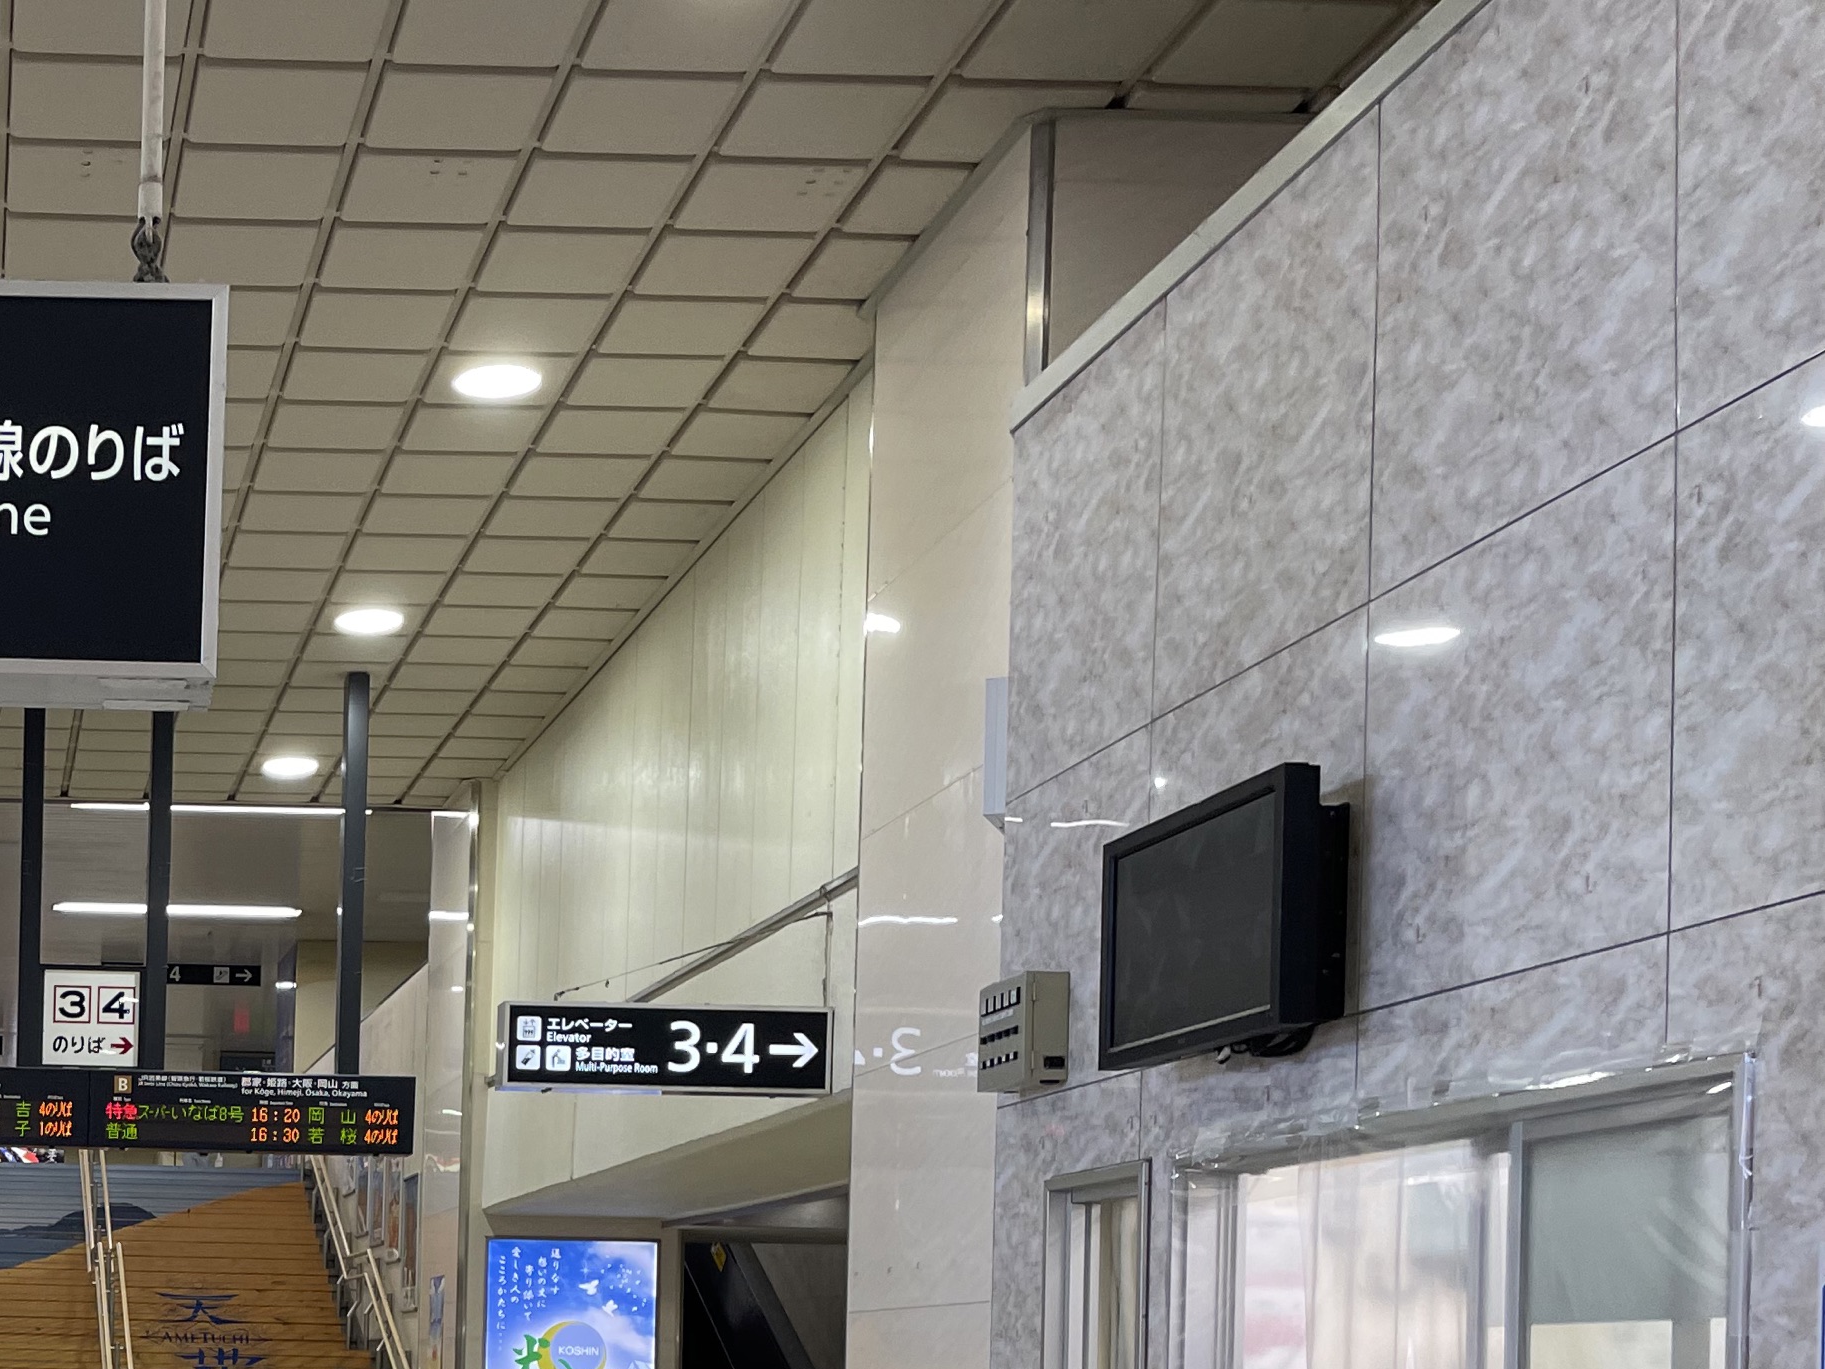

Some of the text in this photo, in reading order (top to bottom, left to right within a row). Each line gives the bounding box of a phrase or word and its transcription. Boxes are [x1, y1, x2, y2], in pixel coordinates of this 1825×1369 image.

[58, 990, 131, 1020] 3 4
[546, 1018, 633, 1032] エレベーター
[52, 1035, 106, 1054] のりば
[546, 1031, 592, 1045] Elevator
[575, 1061, 659, 1076] Multi-Purpose Room
[117, 1077, 129, 1092] B
[331, 1089, 368, 1099] Okayama
[105, 1101, 138, 1120] 特急
[105, 1121, 138, 1140] 普通
[558, 1345, 600, 1357] KOSHIN
